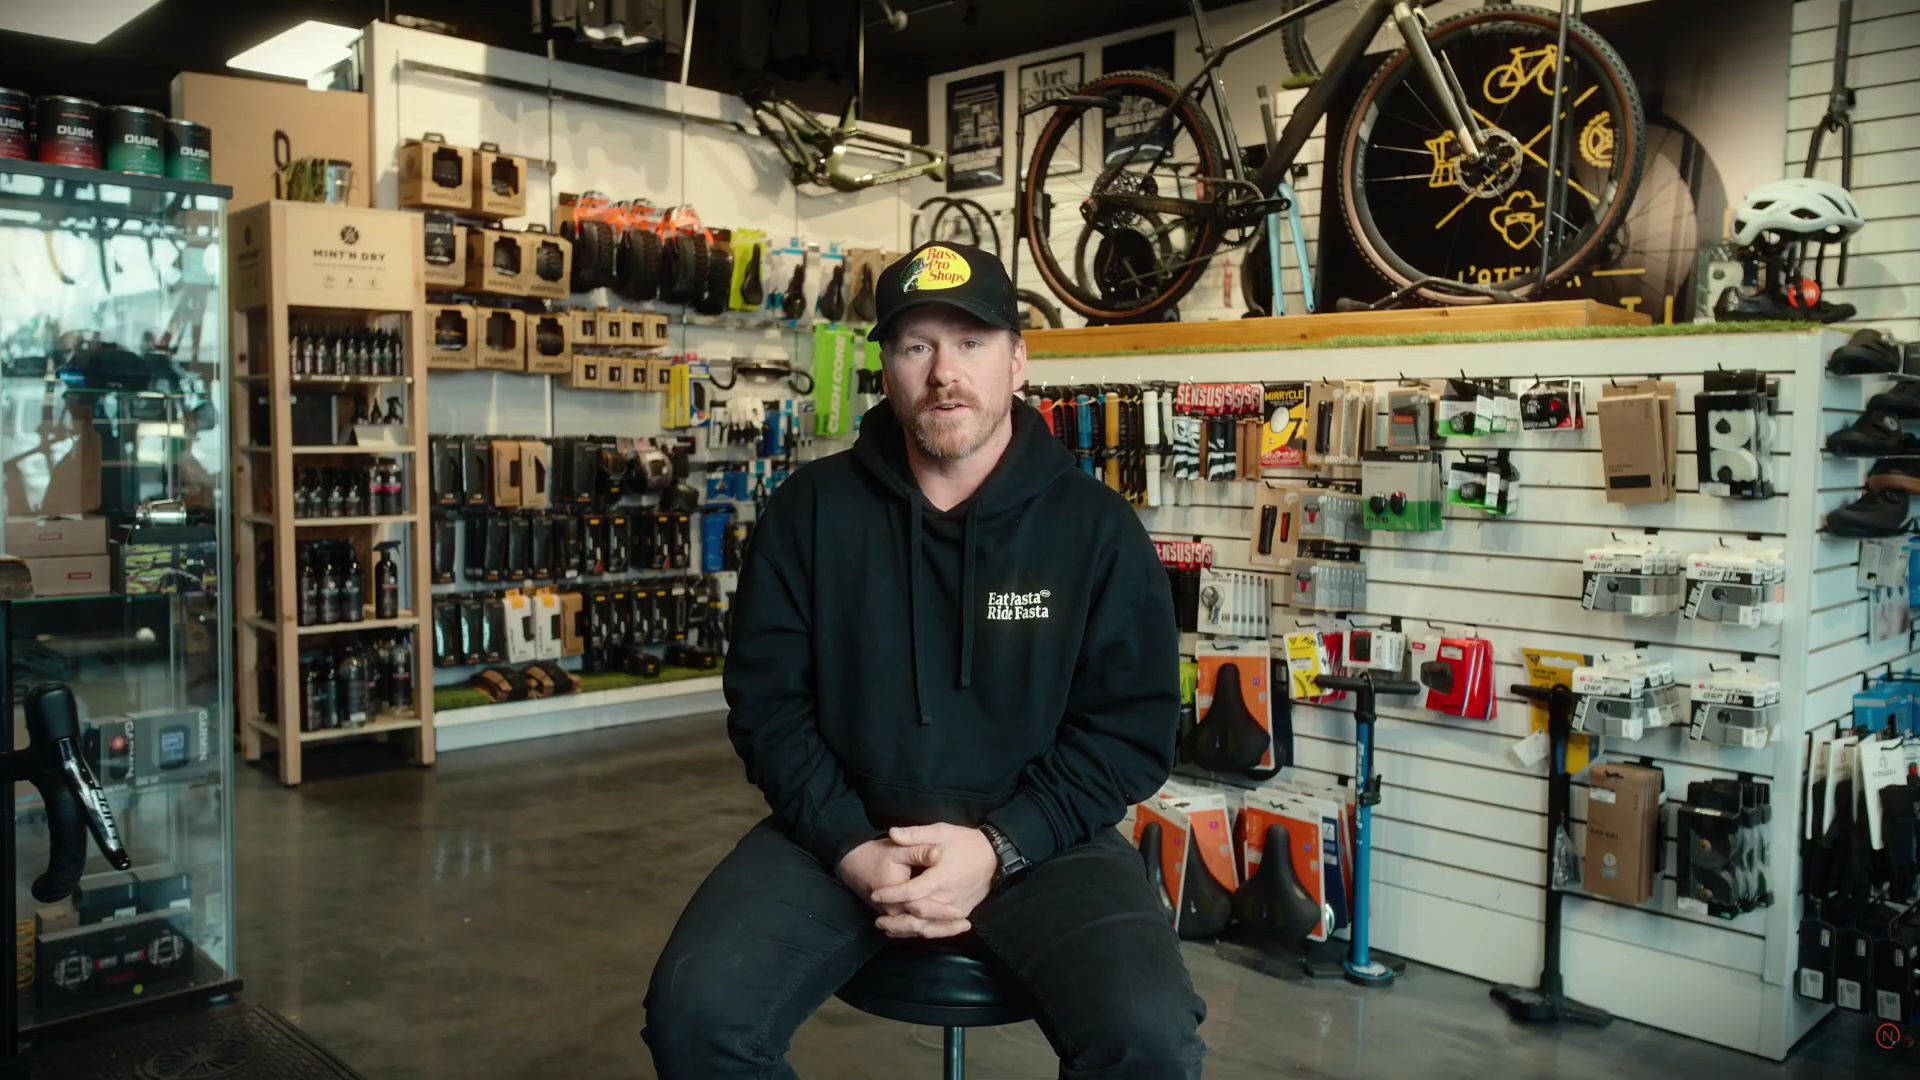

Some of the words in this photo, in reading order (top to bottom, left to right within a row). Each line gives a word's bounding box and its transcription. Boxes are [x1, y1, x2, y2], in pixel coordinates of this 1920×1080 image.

[0, 116, 25, 130] USK
[56, 124, 94, 138] DUSK
[124, 133, 159, 147] DUSK
[180, 145, 211, 159] DUSK
[361, 252, 386, 263] DRY
[927, 248, 957, 261] Bass
[928, 259, 950, 271] Pro
[927, 270, 965, 284] Shops
[832, 334, 847, 384] CORE
[1177, 384, 1222, 408] SENSUS
[1264, 389, 1304, 402] MIRRYCLE
[828, 384, 842, 434] CUSH
[1156, 542, 1192, 564] ENSUS
[988, 592, 1009, 606] Eat
[1010, 591, 1041, 606] Pasta
[987, 605, 1013, 620] Ride
[1014, 604, 1049, 620] Fasta
[198, 710, 208, 762] GARMIN
